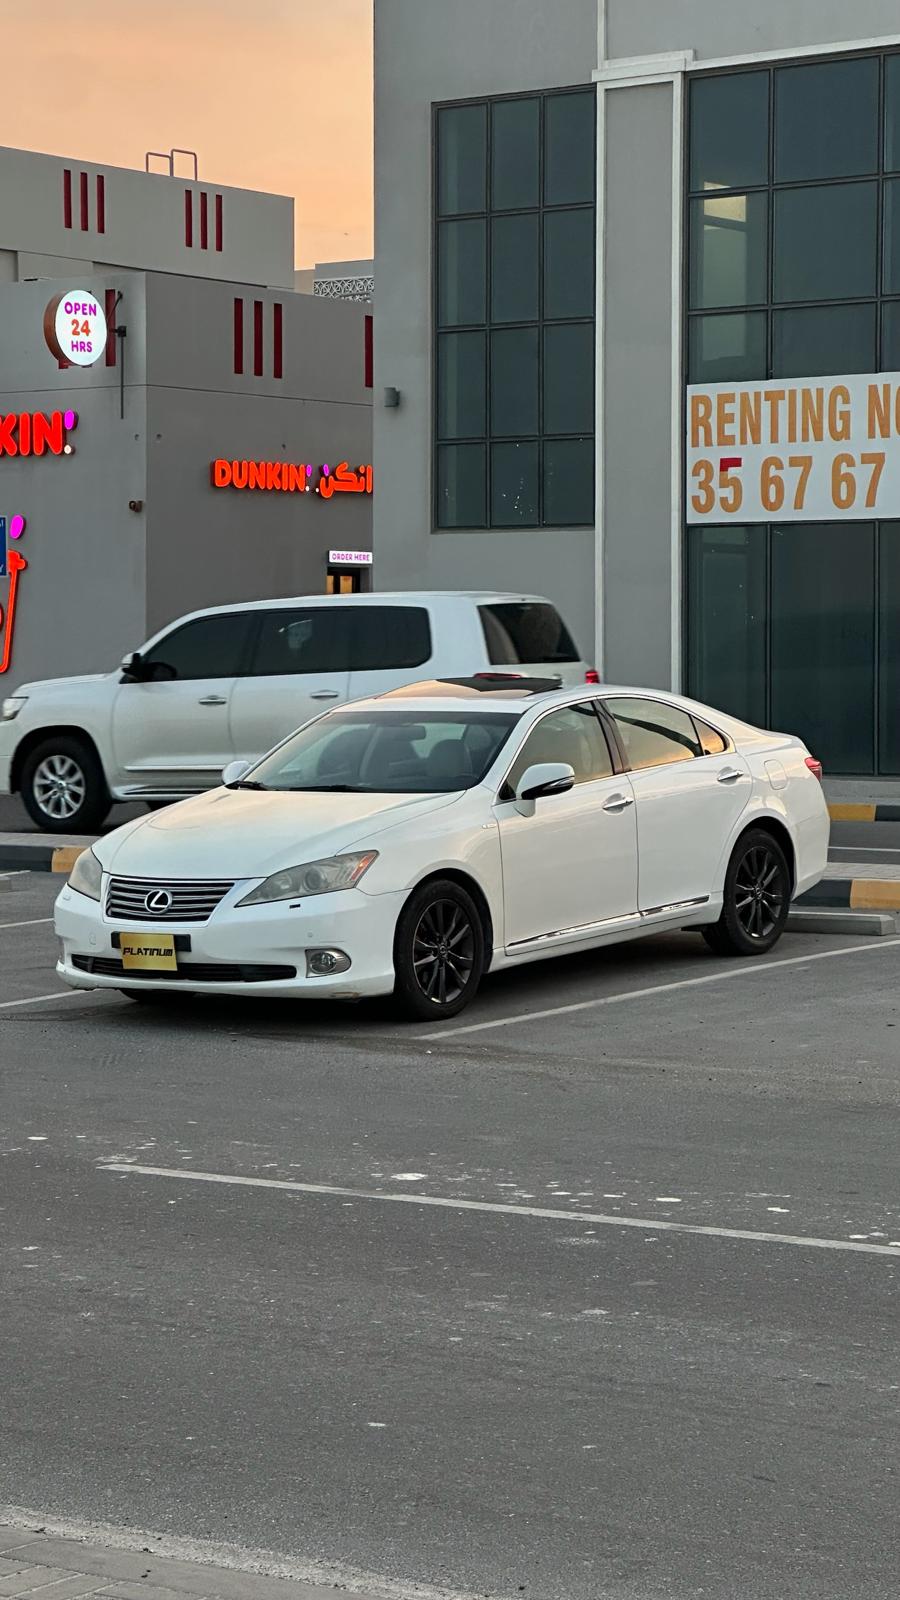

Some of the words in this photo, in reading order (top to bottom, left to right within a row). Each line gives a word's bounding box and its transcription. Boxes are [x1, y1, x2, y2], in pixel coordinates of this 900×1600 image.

[64, 301, 97, 316] OPEN
[71, 318, 91, 336] 24
[71, 340, 93, 352] HRS
[690, 384, 851, 448] RENTING
[867, 383, 900, 439] N
[691, 457, 743, 513] 35
[760, 455, 813, 512] 67
[831, 452, 886, 509] 67
[331, 553, 353, 561] ORDER
[354, 554, 370, 562] HERE
[123, 947, 173, 957] PLATINUM
